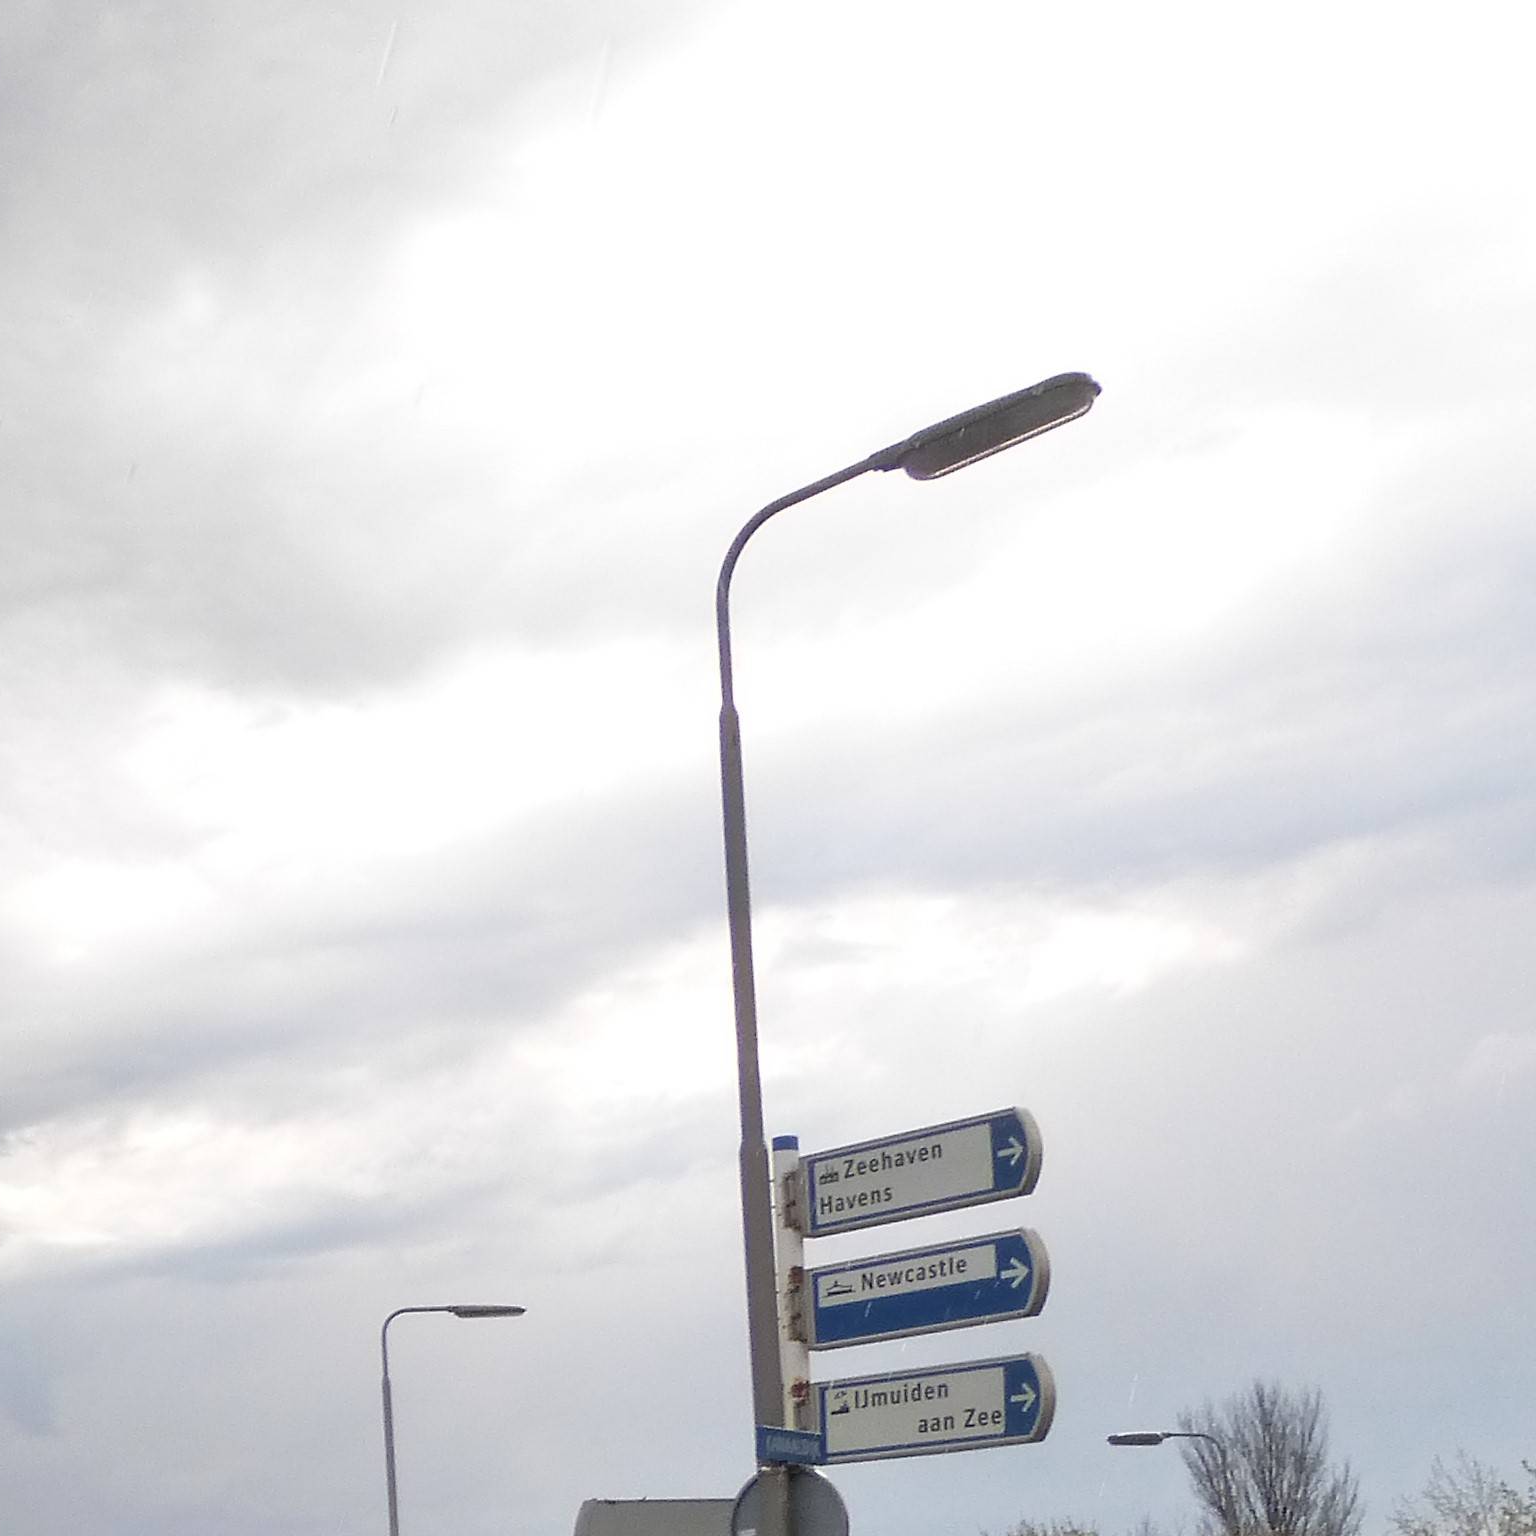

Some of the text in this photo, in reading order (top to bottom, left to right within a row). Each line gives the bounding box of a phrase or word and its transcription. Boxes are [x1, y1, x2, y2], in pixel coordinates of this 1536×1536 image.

[843, 1143, 942, 1179] Zeehaven
[820, 1187, 893, 1215] Havens
[862, 1257, 967, 1290] Newcastle
[854, 1382, 948, 1408] IJmuiden
[919, 1408, 1003, 1433] aan Zee
